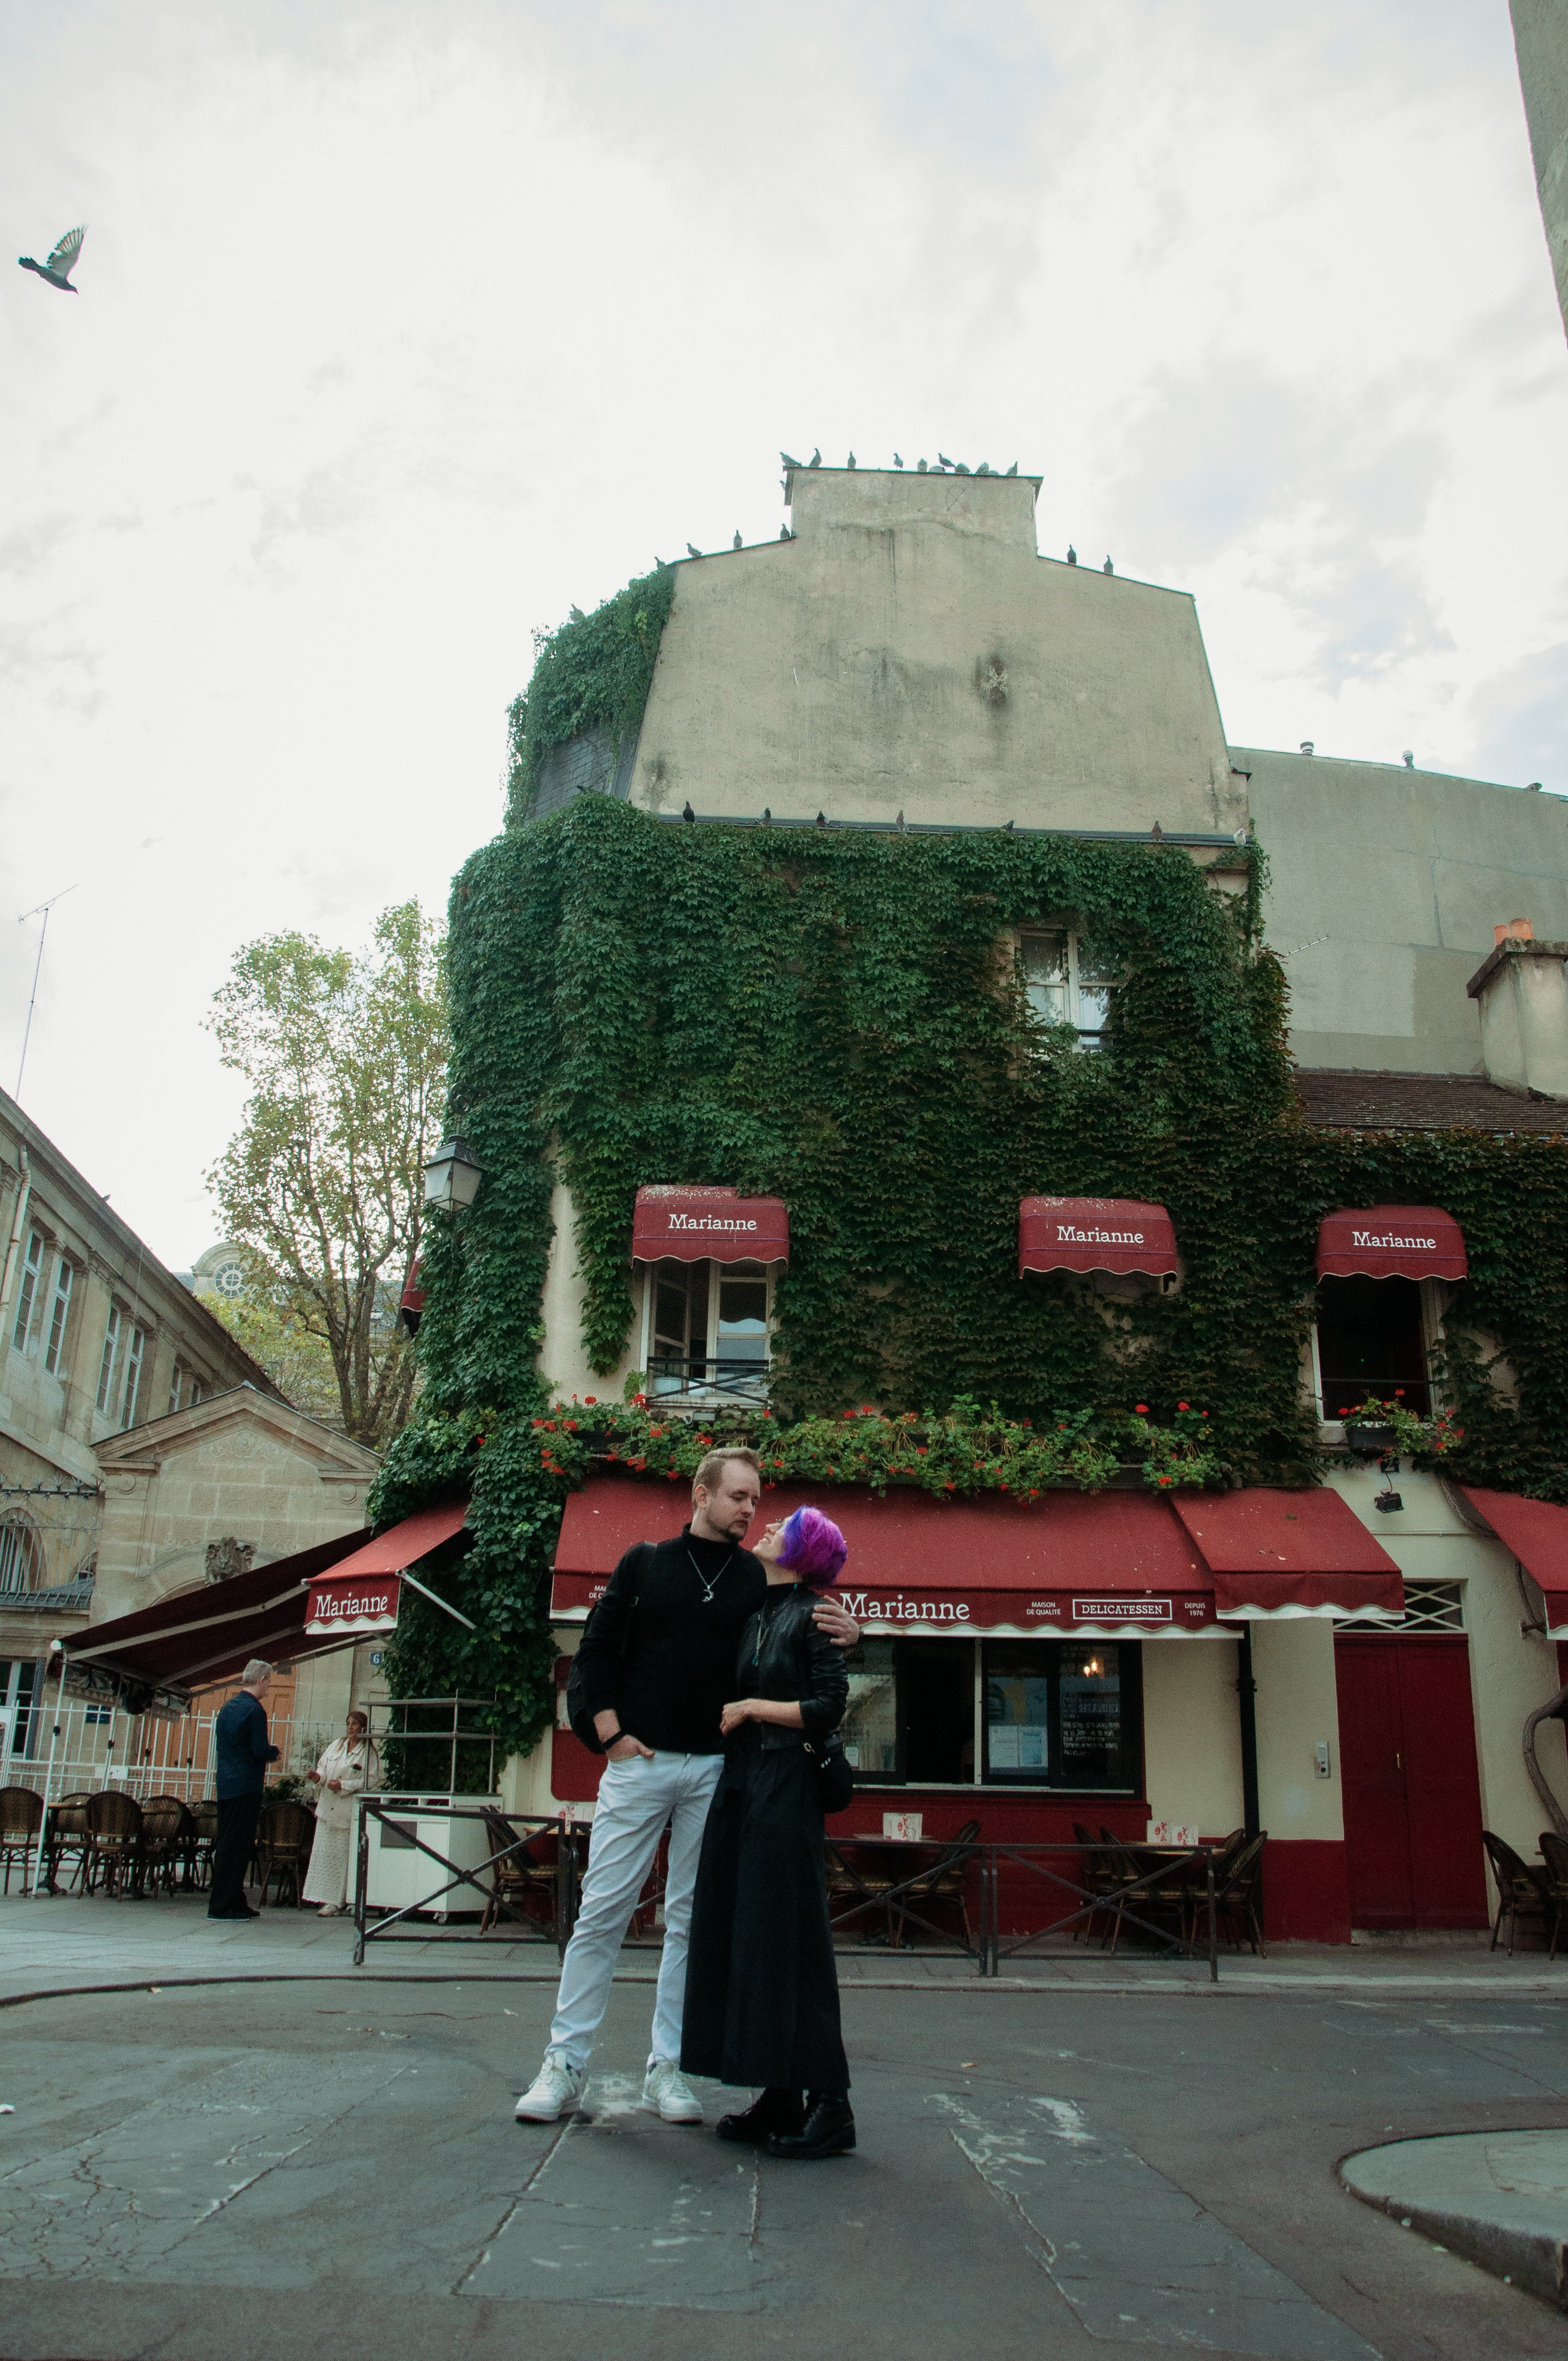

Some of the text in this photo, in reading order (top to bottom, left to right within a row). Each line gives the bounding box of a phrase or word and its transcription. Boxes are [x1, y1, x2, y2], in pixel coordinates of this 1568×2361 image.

[668, 1213, 757, 1230] Marianne
[1057, 1226, 1144, 1244] Marianne
[1352, 1231, 1436, 1249] Marianne
[314, 1592, 388, 1617] Marianne
[839, 1592, 970, 1621] Marianne
[1082, 1605, 1163, 1614] DELICATESSEN
[373, 1654, 380, 1664] 6
